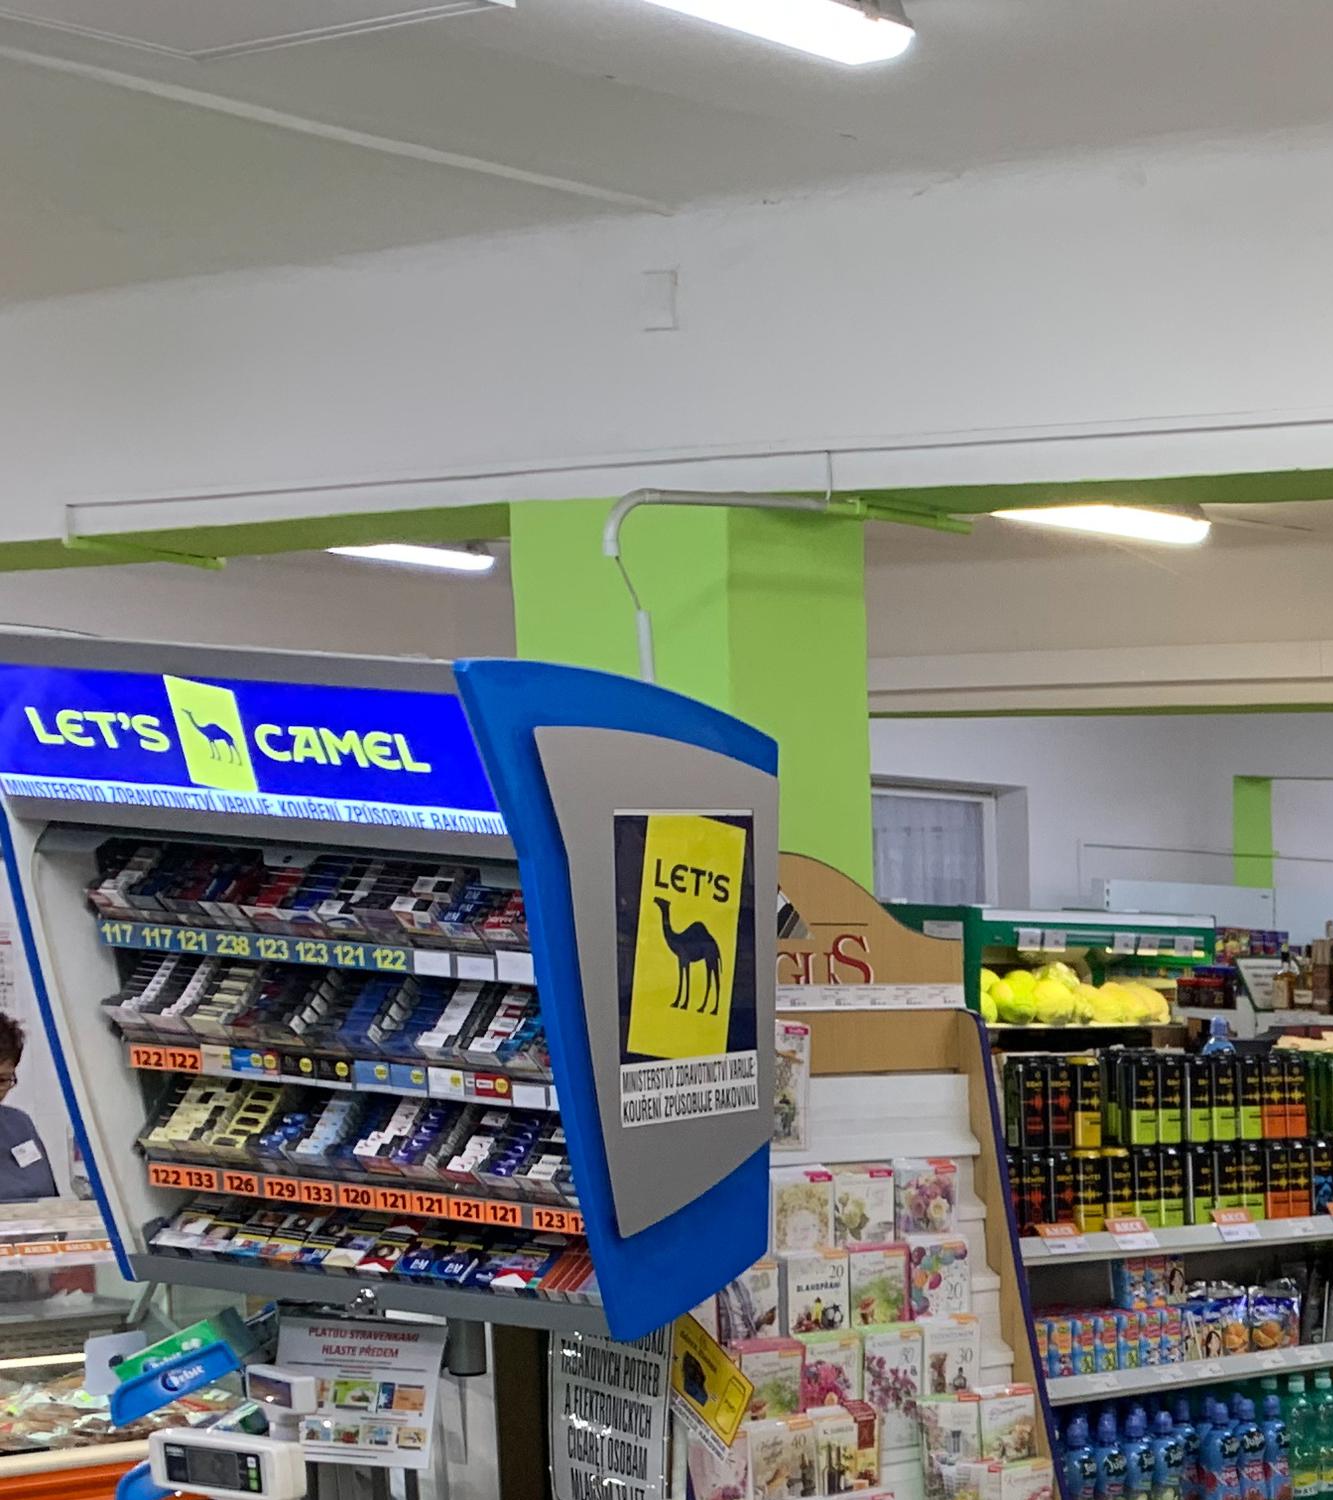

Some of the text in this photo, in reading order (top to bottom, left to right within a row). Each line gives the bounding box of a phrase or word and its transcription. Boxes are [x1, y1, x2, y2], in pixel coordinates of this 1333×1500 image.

[25, 706, 432, 773] LET'S CAMEL
[5, 779, 106, 802] MINISTERSTVO
[653, 858, 730, 903] LET'S
[102, 922, 407, 971] 117 117 121 238 123 123 121 122
[133, 1050, 200, 1070] 122 122
[622, 1065, 675, 1094] MINISTERSTVO
[623, 1084, 757, 1124] KOUŘENÍ ZPŮSOBUJE RAKOVINU
[151, 1168, 566, 1230] 122 133 126 129 133 120 121 121 121 121 123
[322, 1345, 357, 1357] HLASTE
